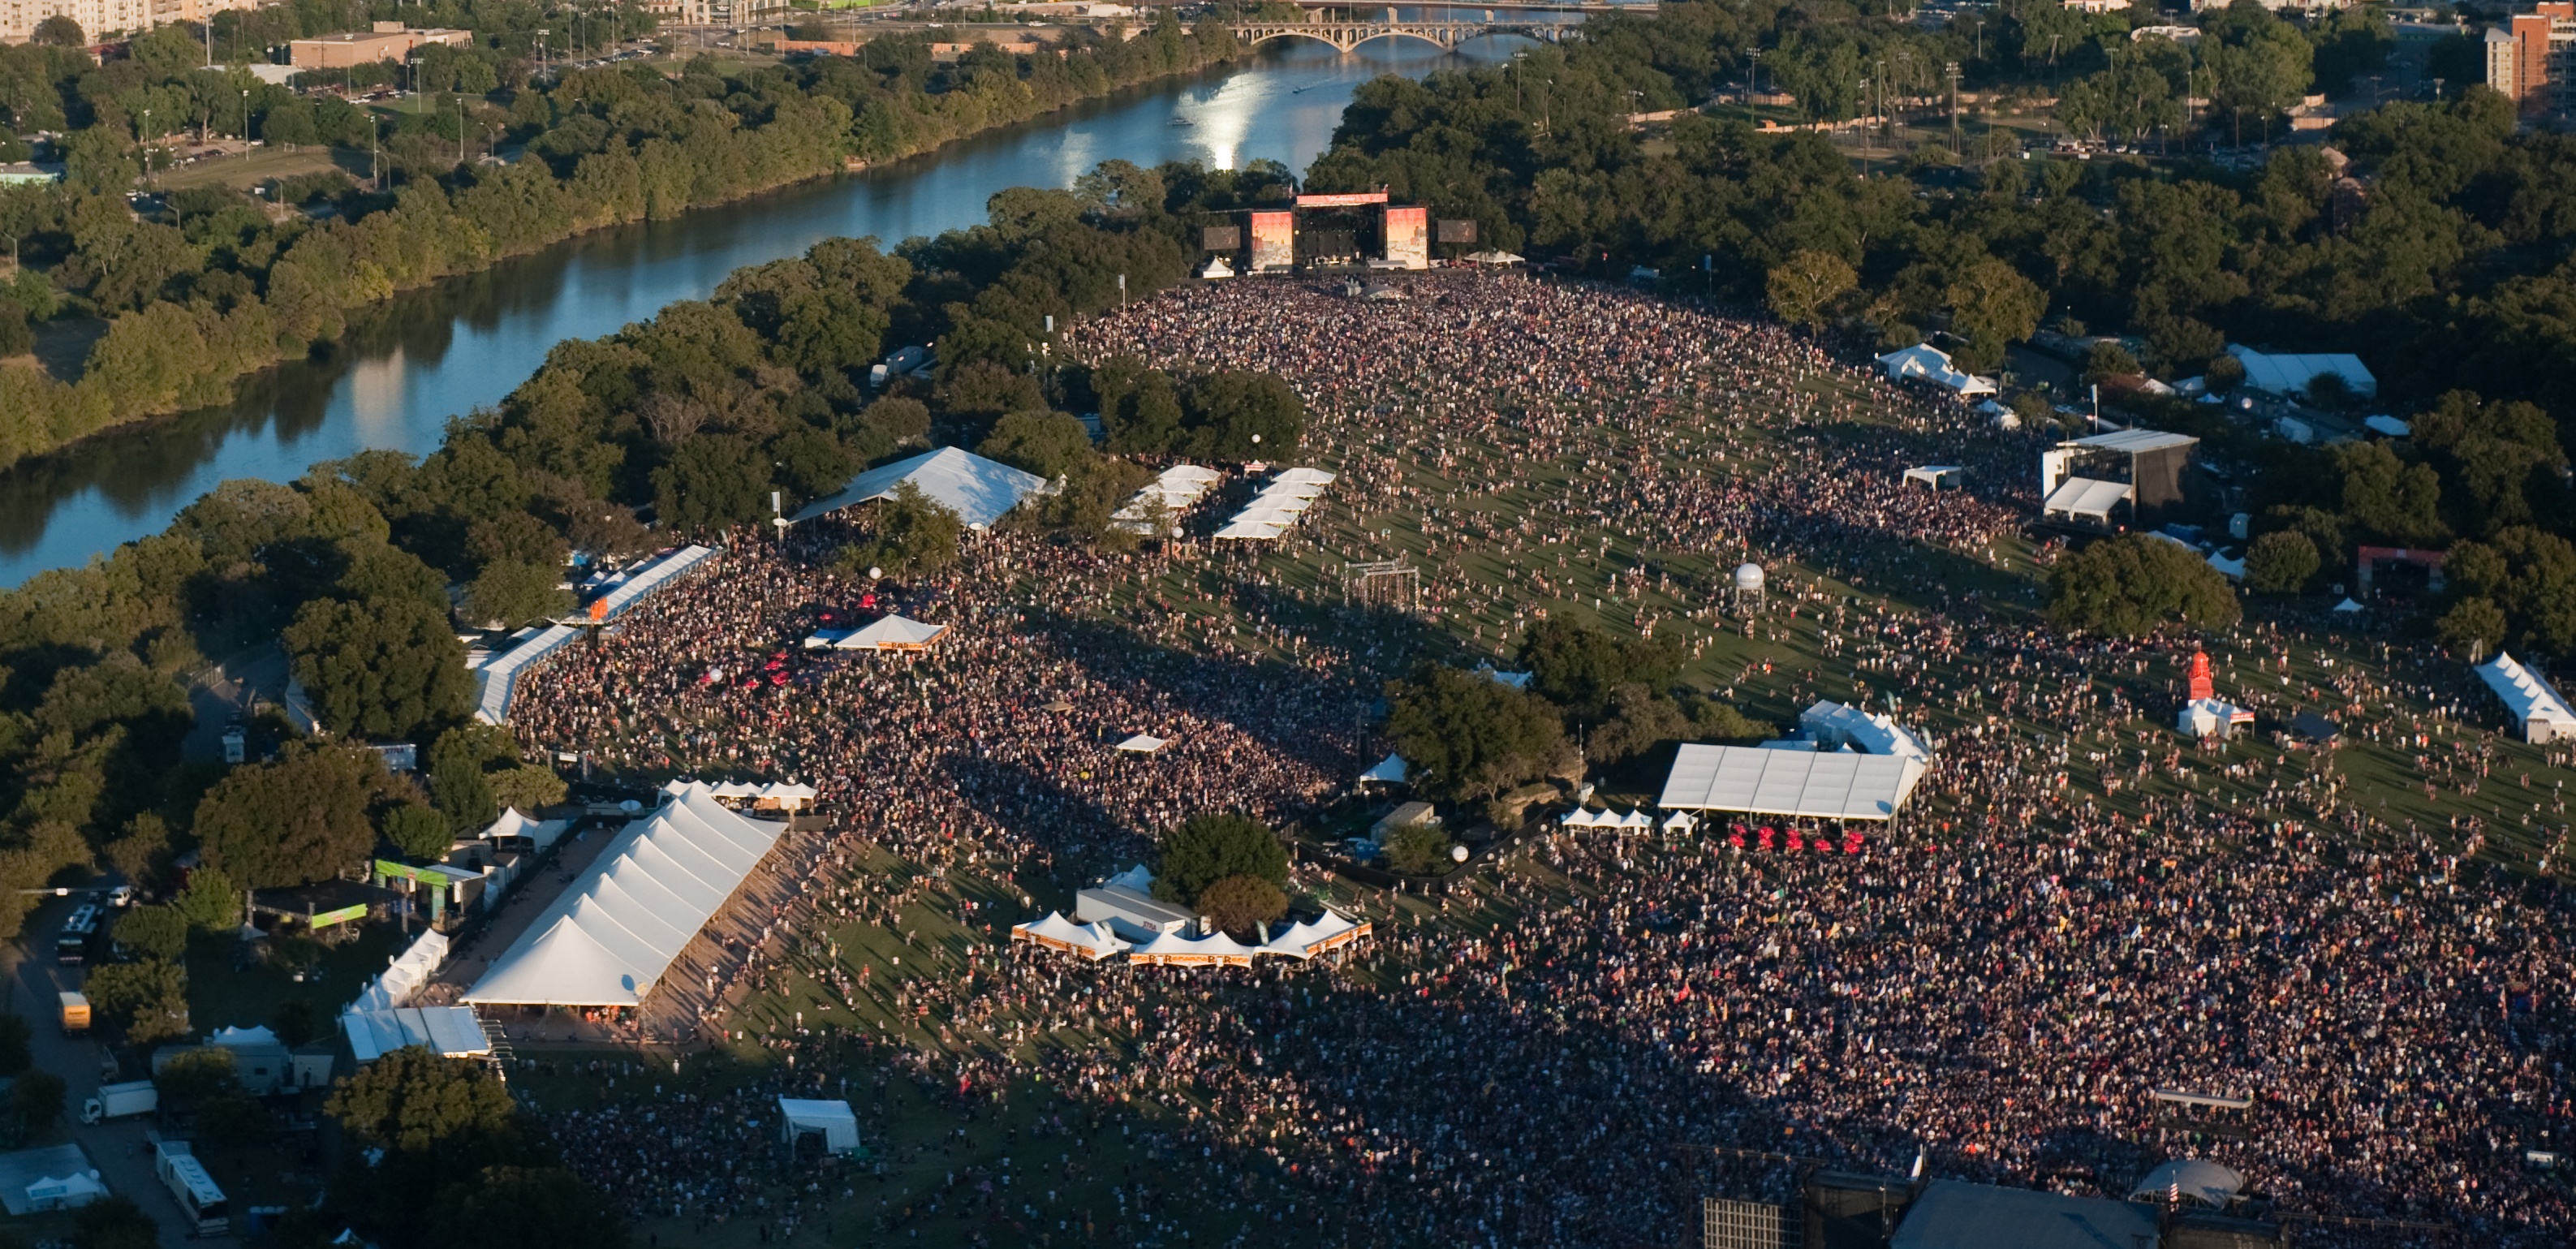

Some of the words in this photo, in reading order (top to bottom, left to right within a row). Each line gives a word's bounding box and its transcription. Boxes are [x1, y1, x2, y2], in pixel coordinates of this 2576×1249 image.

[1143, 920, 1157, 930] XTRA
[1148, 954, 1172, 963] BR
[1208, 955, 1231, 963] BR
